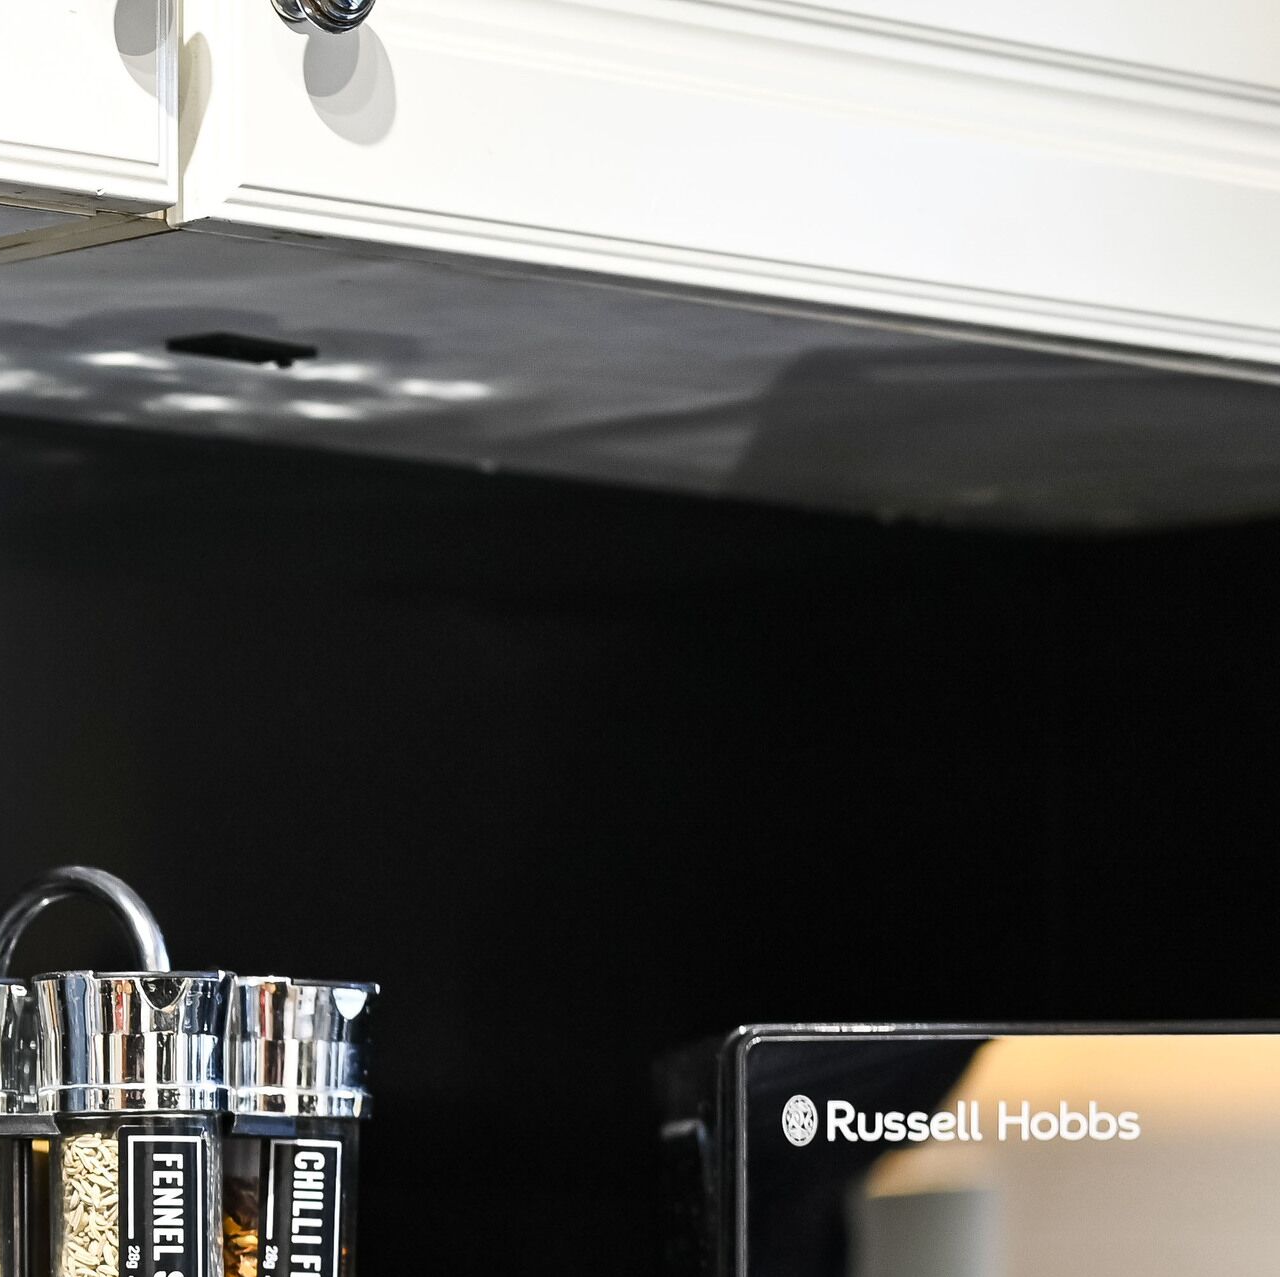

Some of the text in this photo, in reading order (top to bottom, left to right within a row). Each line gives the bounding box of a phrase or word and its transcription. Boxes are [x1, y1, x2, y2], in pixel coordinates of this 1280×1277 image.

[826, 1100, 1141, 1142] Russell Hobbs
[152, 1153, 185, 1261] FENNEL
[291, 1151, 326, 1245] CHILLI
[125, 1245, 140, 1269] 28g
[262, 1245, 278, 1269] 28g
